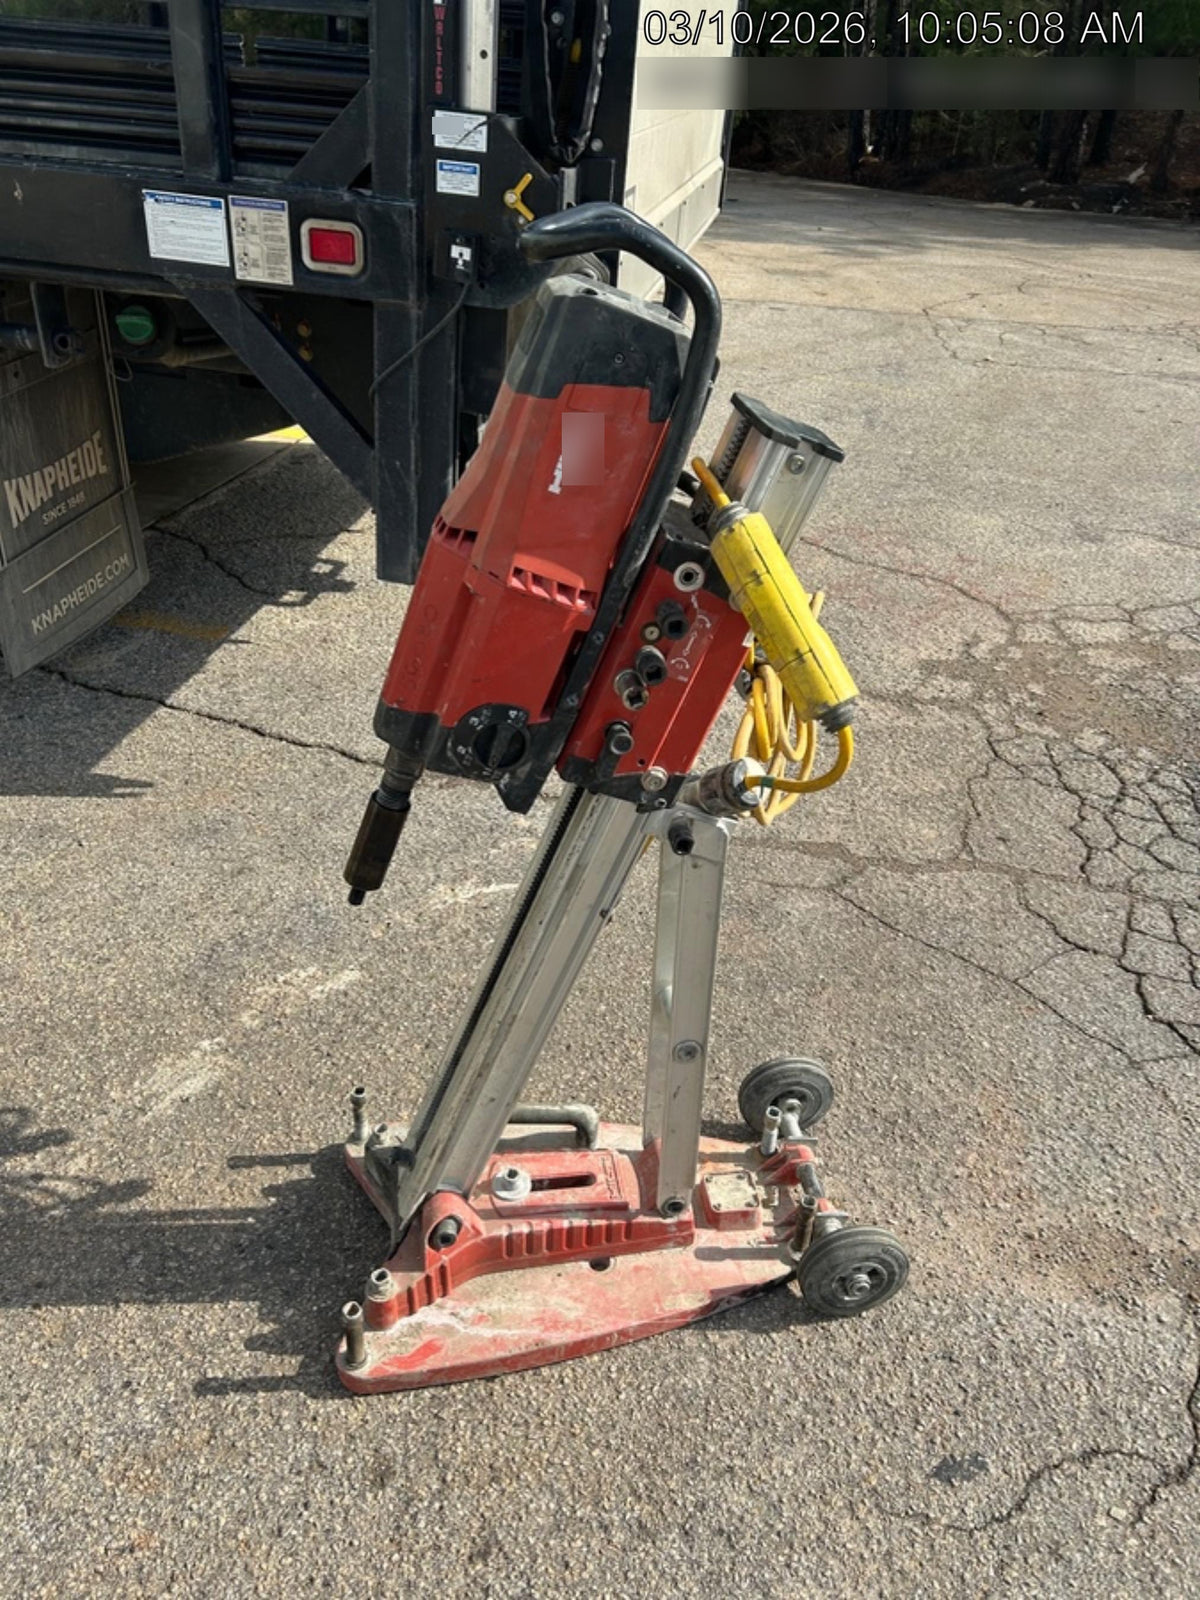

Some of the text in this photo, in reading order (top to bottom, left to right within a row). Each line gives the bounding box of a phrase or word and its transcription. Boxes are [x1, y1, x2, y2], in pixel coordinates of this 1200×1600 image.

[4, 431, 107, 528] KNAPHEIDE
[42, 503, 67, 525] SINCE
[31, 553, 130, 635] KNAPHEIDE.COM
